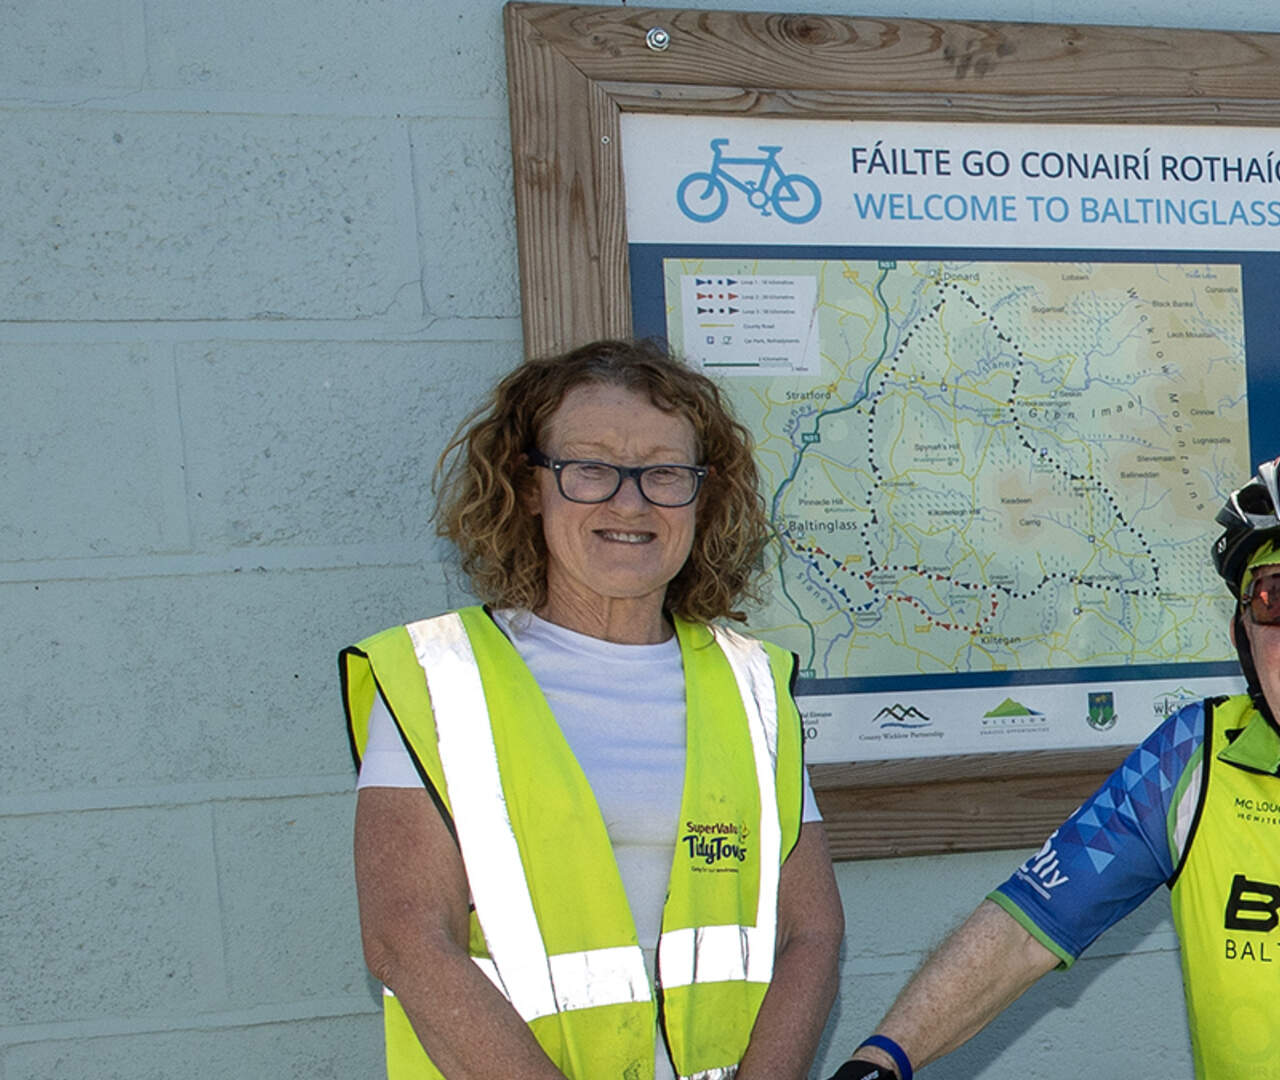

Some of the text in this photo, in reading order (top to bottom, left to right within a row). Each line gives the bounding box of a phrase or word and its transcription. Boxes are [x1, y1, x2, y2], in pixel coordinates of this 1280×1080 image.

[851, 141, 951, 176] FÁILTE
[962, 150, 1009, 177] GO
[1021, 148, 1149, 180] CONAIRÍ
[853, 193, 1016, 221] WELCOME
[1026, 196, 1069, 222] TO
[944, 272, 979, 281] Donard
[785, 391, 831, 400] Stratford
[789, 520, 857, 533] Baltinglass
[1019, 519, 1041, 527] Carrig
[980, 636, 1021, 645] Kiltegan
[982, 718, 1047, 726] WICKLOW
[1235, 798, 1253, 810] MC
